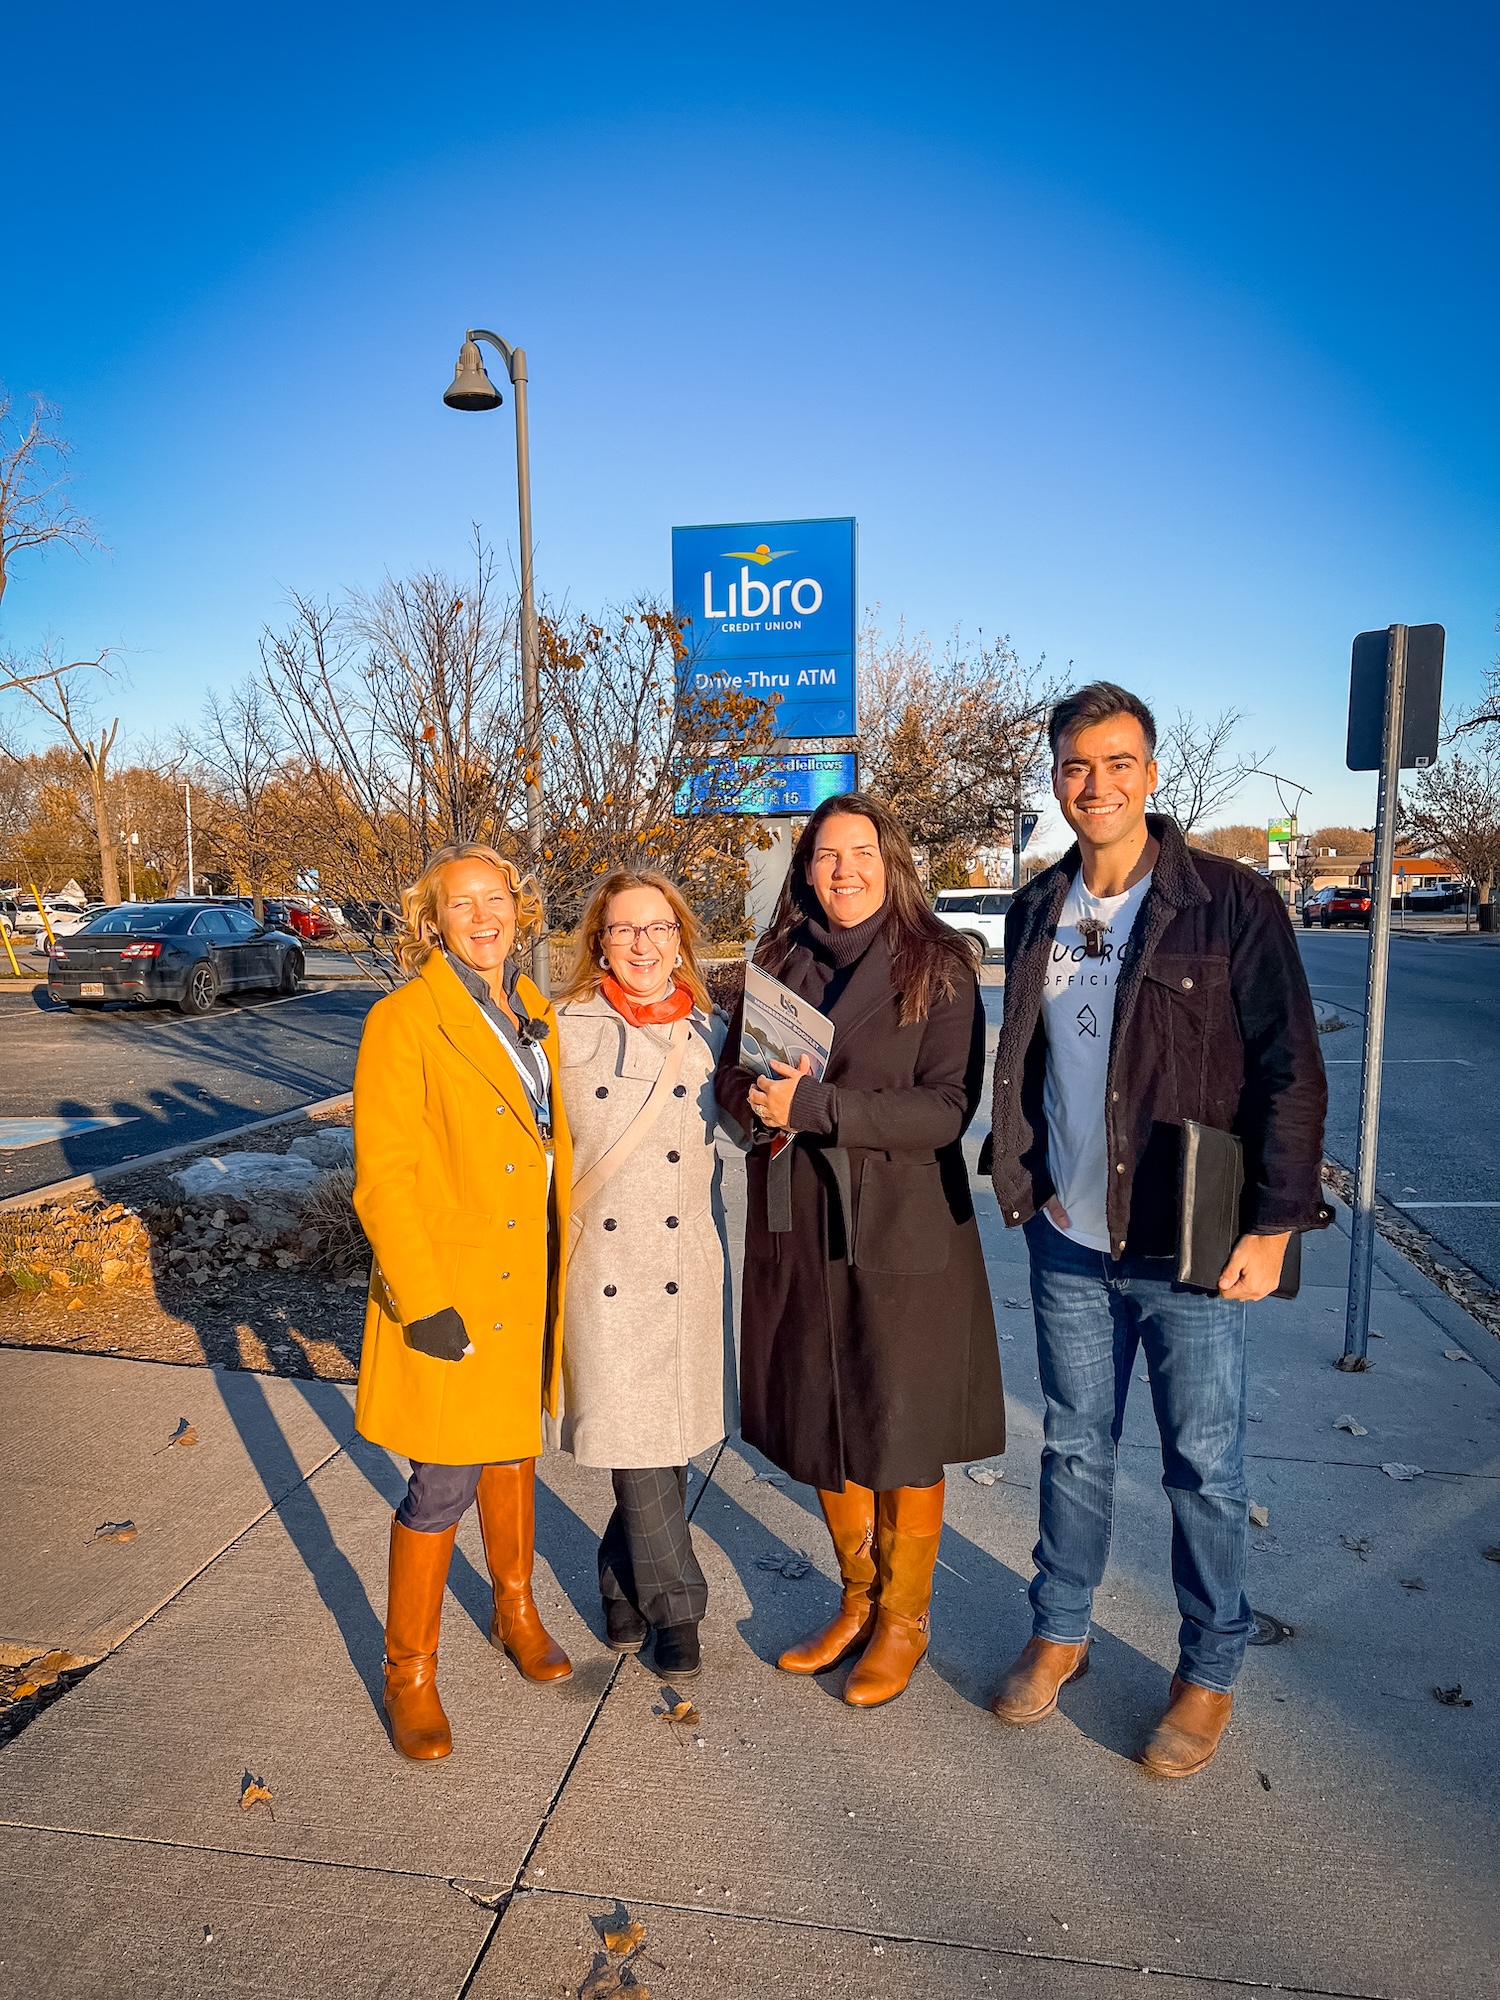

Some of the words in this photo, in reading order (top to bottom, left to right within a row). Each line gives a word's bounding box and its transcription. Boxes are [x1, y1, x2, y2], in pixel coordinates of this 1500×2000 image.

[704, 565, 823, 618] Libro
[721, 622, 761, 633] CREDIT
[765, 620, 802, 631] UNION
[695, 671, 790, 690] Drive-Thru
[796, 669, 836, 686] ATM
[783, 791, 800, 805] 15
[1043, 975, 1118, 986] OFFICI
[754, 998, 793, 1029] MEMBERSHIP
[792, 1024, 820, 1050] BOOKLET
